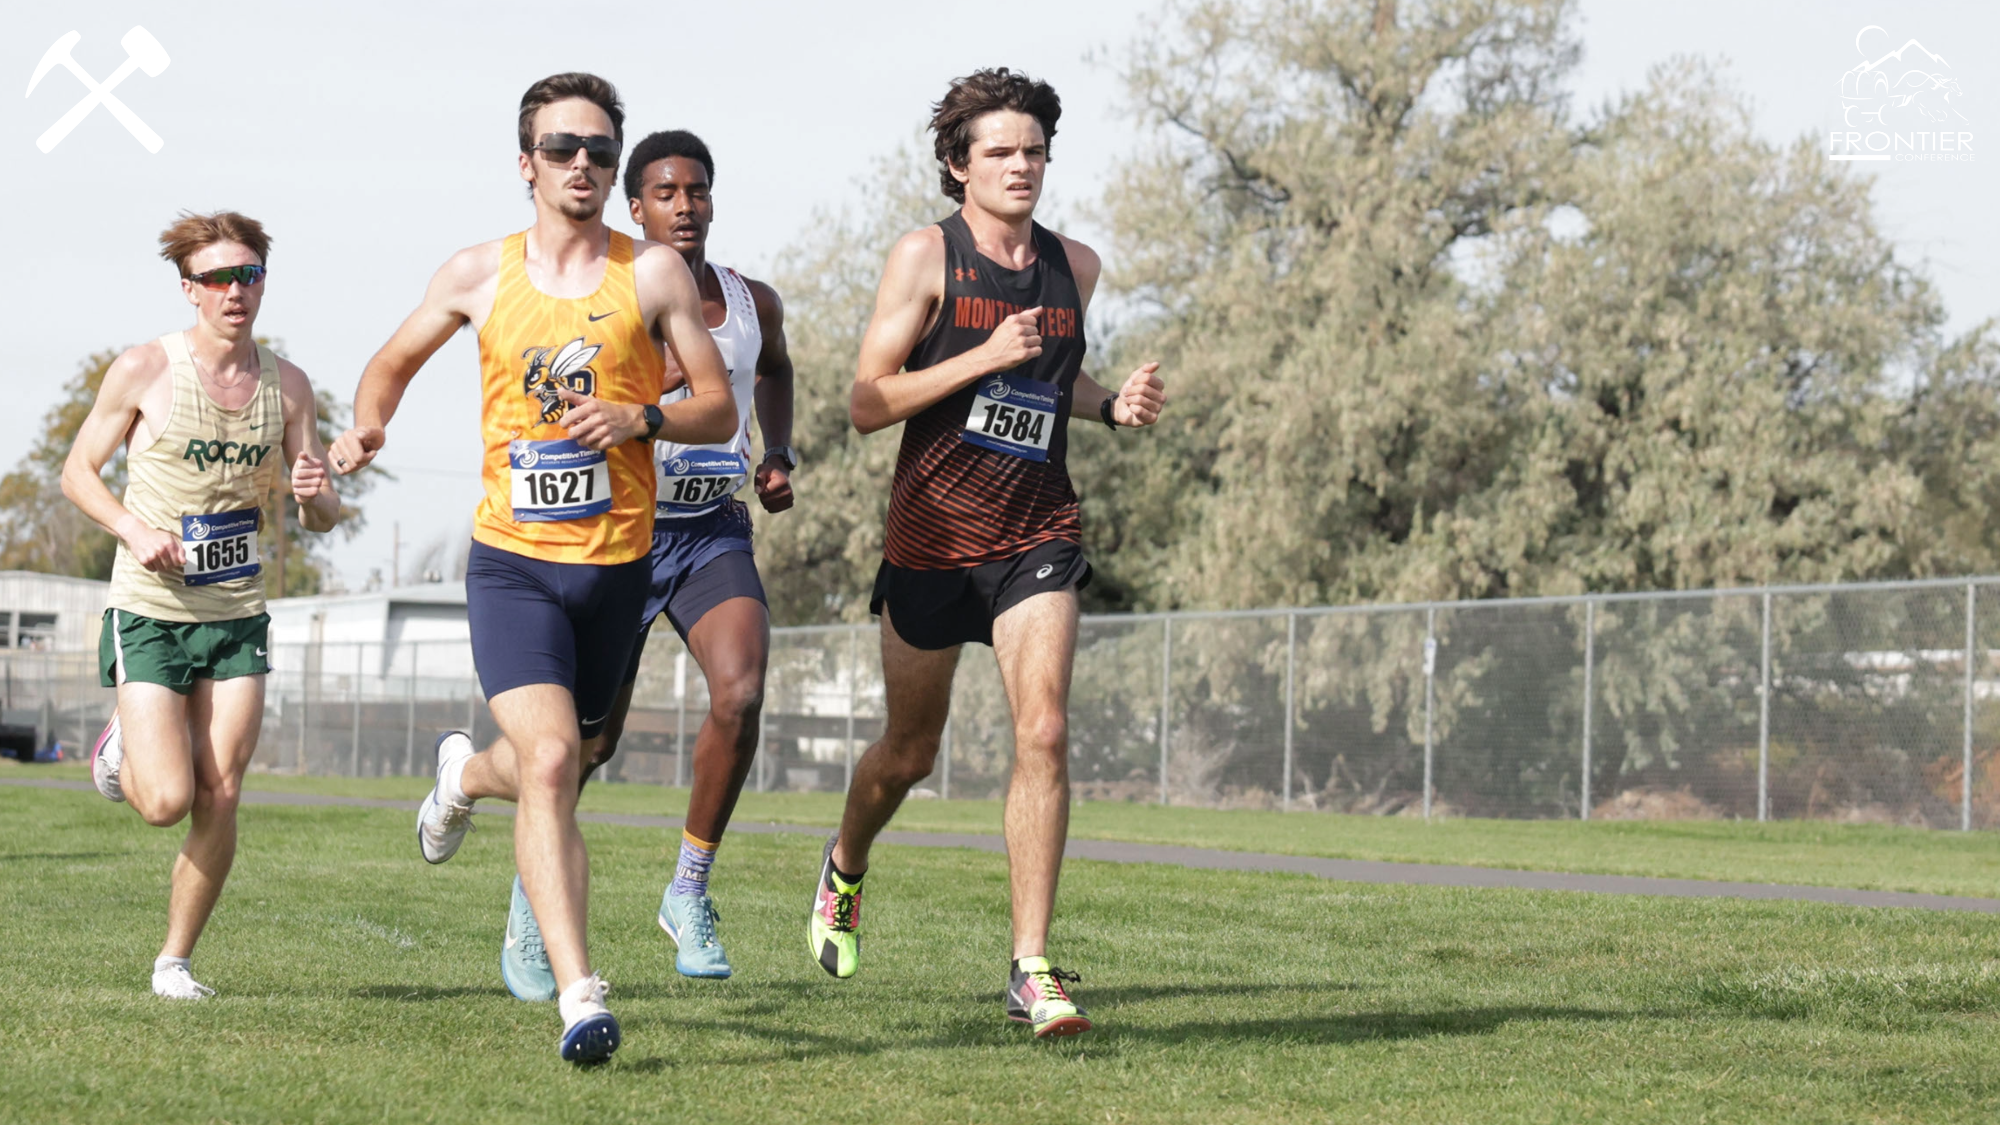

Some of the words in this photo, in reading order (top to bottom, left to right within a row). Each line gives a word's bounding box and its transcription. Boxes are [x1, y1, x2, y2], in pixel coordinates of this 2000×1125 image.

[982, 403, 1046, 445] 1584
[183, 439, 271, 471] ROCKY
[524, 468, 594, 505] 1627
[672, 476, 731, 502] 1673
[192, 536, 249, 572] 1655
